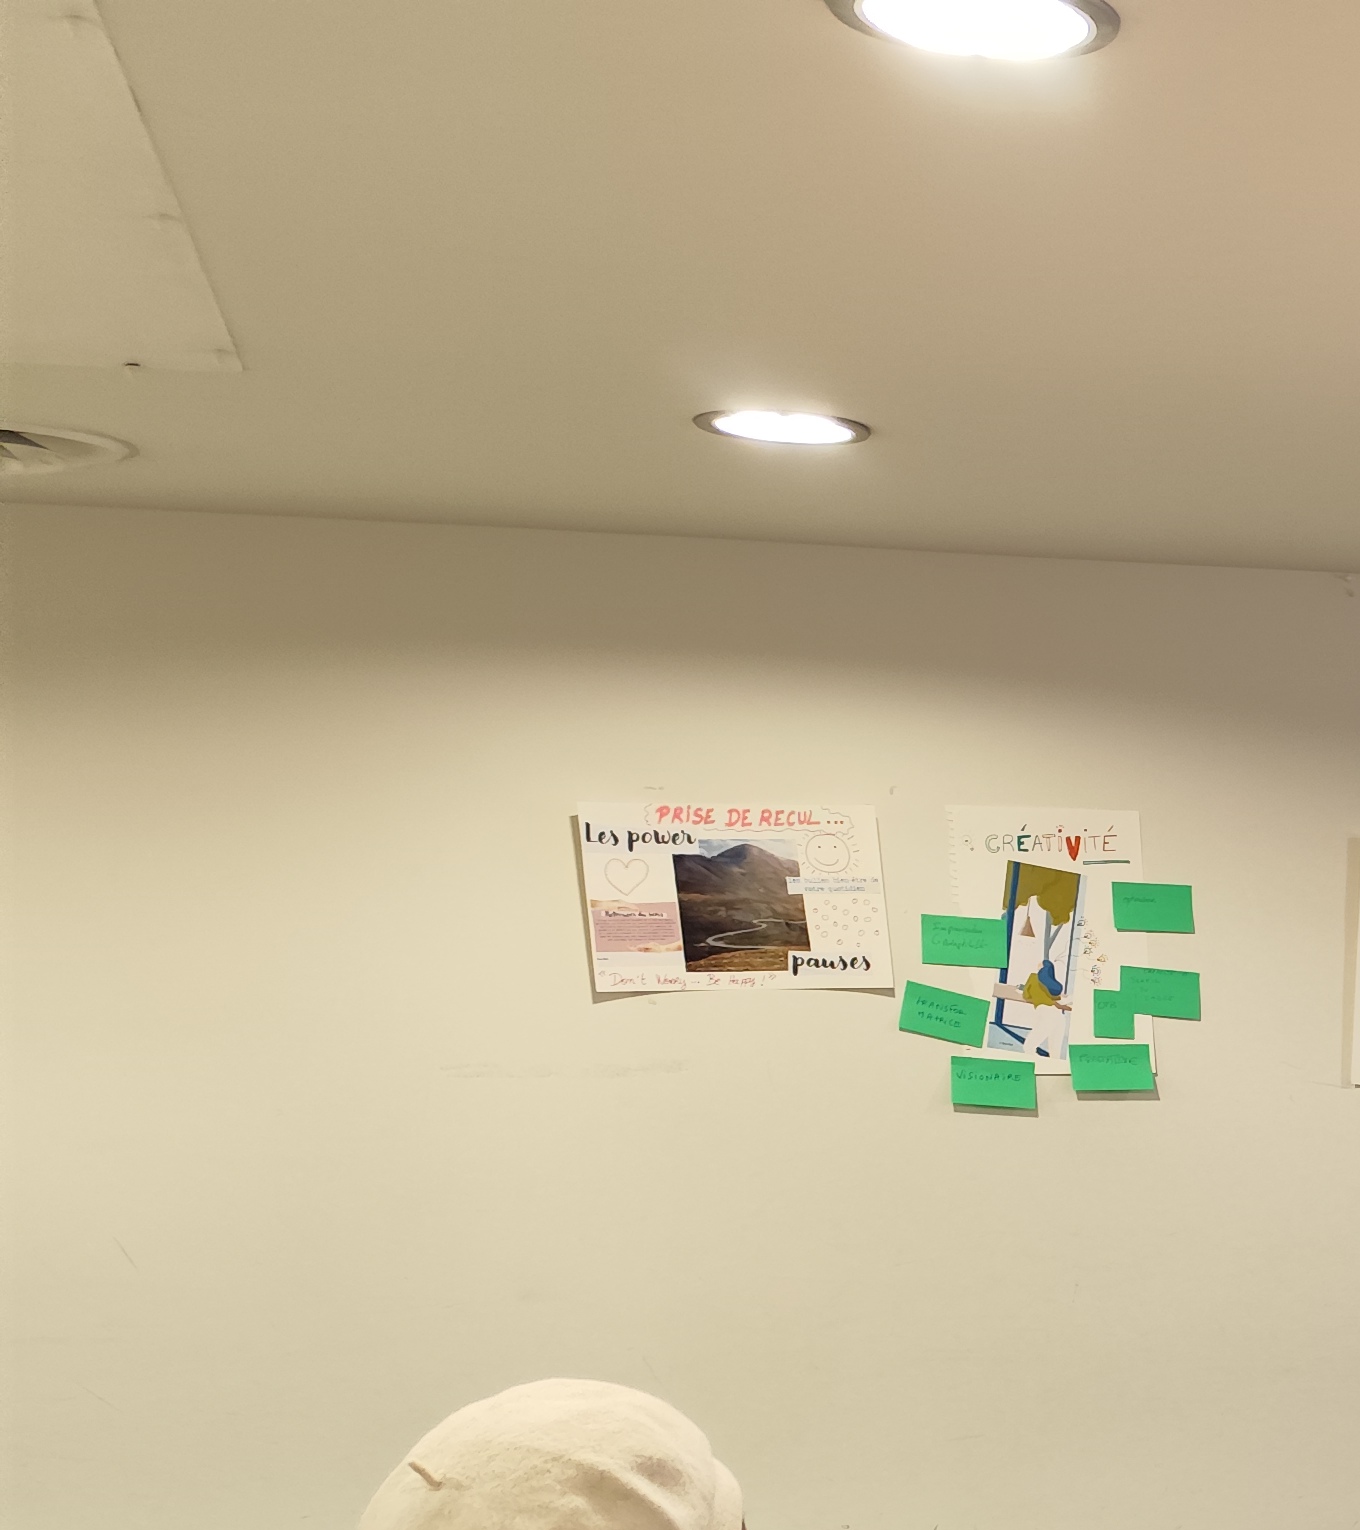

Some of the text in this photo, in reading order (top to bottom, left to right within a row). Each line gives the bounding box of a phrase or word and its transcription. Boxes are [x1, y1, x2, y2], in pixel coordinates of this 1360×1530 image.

[655, 804, 716, 825] PRISE
[725, 808, 752, 828] DE
[585, 821, 697, 852] Les power
[984, 823, 1118, 862] CRÉATIVITÉ
[792, 953, 871, 976] pauses
